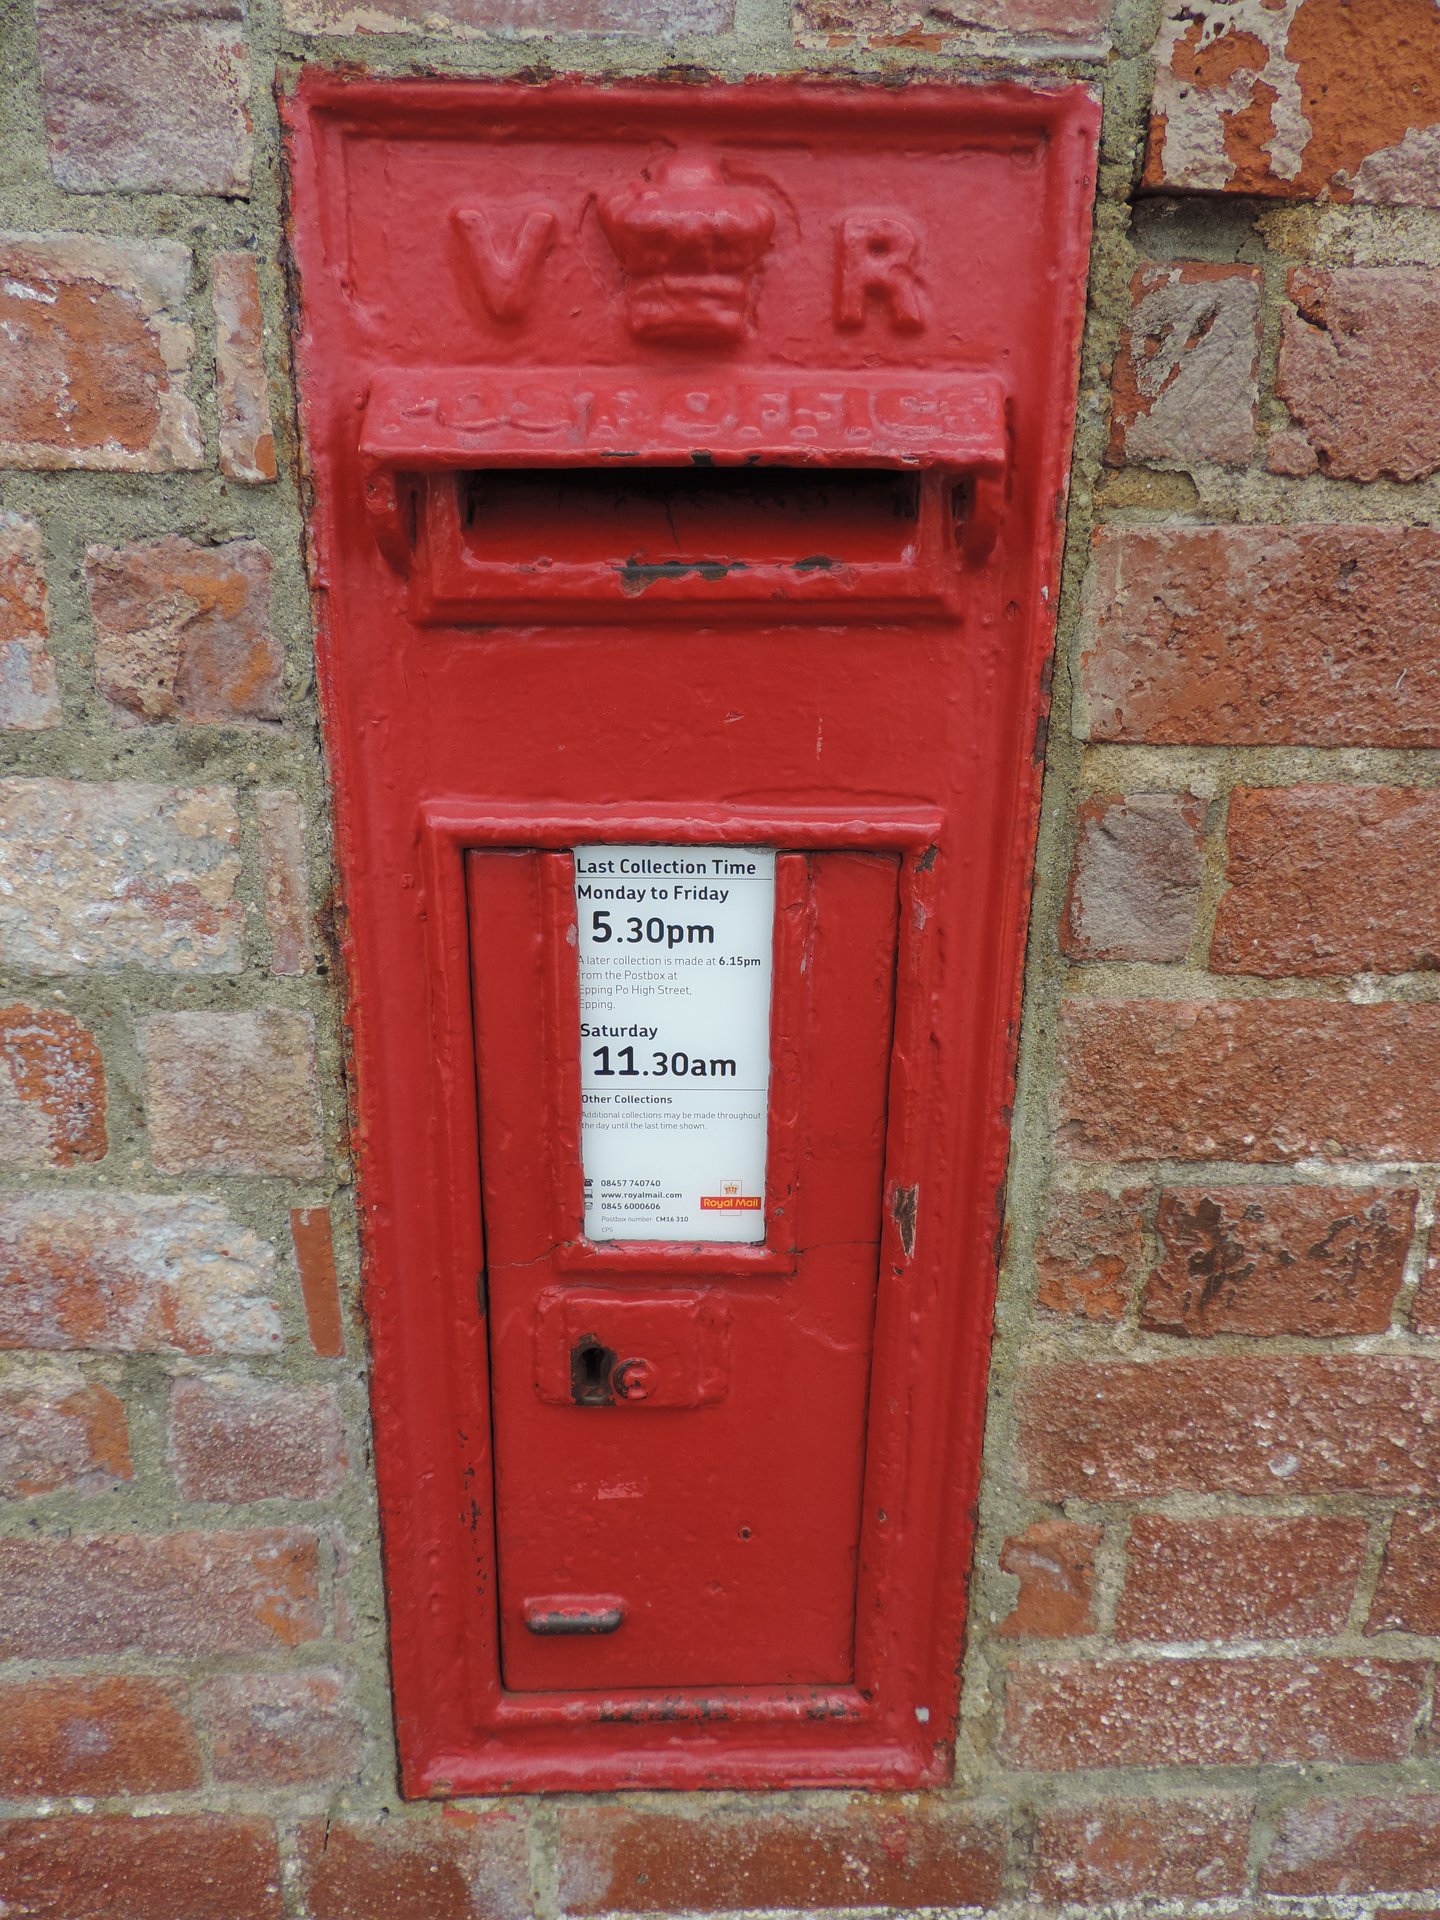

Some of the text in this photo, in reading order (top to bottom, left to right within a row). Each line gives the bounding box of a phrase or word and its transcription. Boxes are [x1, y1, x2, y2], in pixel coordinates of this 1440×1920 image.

[448, 206, 926, 331] V R
[577, 859, 756, 874] Last Collection Time
[578, 885, 729, 903] Monday to Friday
[592, 910, 714, 949] 5.30pm
[587, 956, 610, 965] later
[613, 956, 661, 966] collection
[664, 956, 672, 966] is
[675, 956, 704, 966] made
[706, 958, 716, 966] at
[719, 956, 761, 968] 6.15pm
[605, 971, 621, 980] the
[624, 970, 665, 980] Postbox
[616, 985, 629, 995] Po
[632, 985, 654, 996] High
[658, 985, 692, 996] Street,
[581, 1024, 658, 1040] Saturday
[593, 1046, 736, 1076] 11.30am
[582, 1095, 672, 1104] Other Collections
[582, 1111, 620, 1119] Additional
[622, 1111, 662, 1119] collections
[664, 1113, 679, 1121] may
[718, 1112, 761, 1121] throughout
[596, 1122, 610, 1131] day
[631, 1122, 643, 1130] the
[645, 1122, 658, 1130] last
[660, 1122, 678, 1130] time
[680, 1122, 707, 1130] shown.
[601, 1191, 682, 1199] www.royalmail.com
[704, 1199, 758, 1208] Royal Mail
